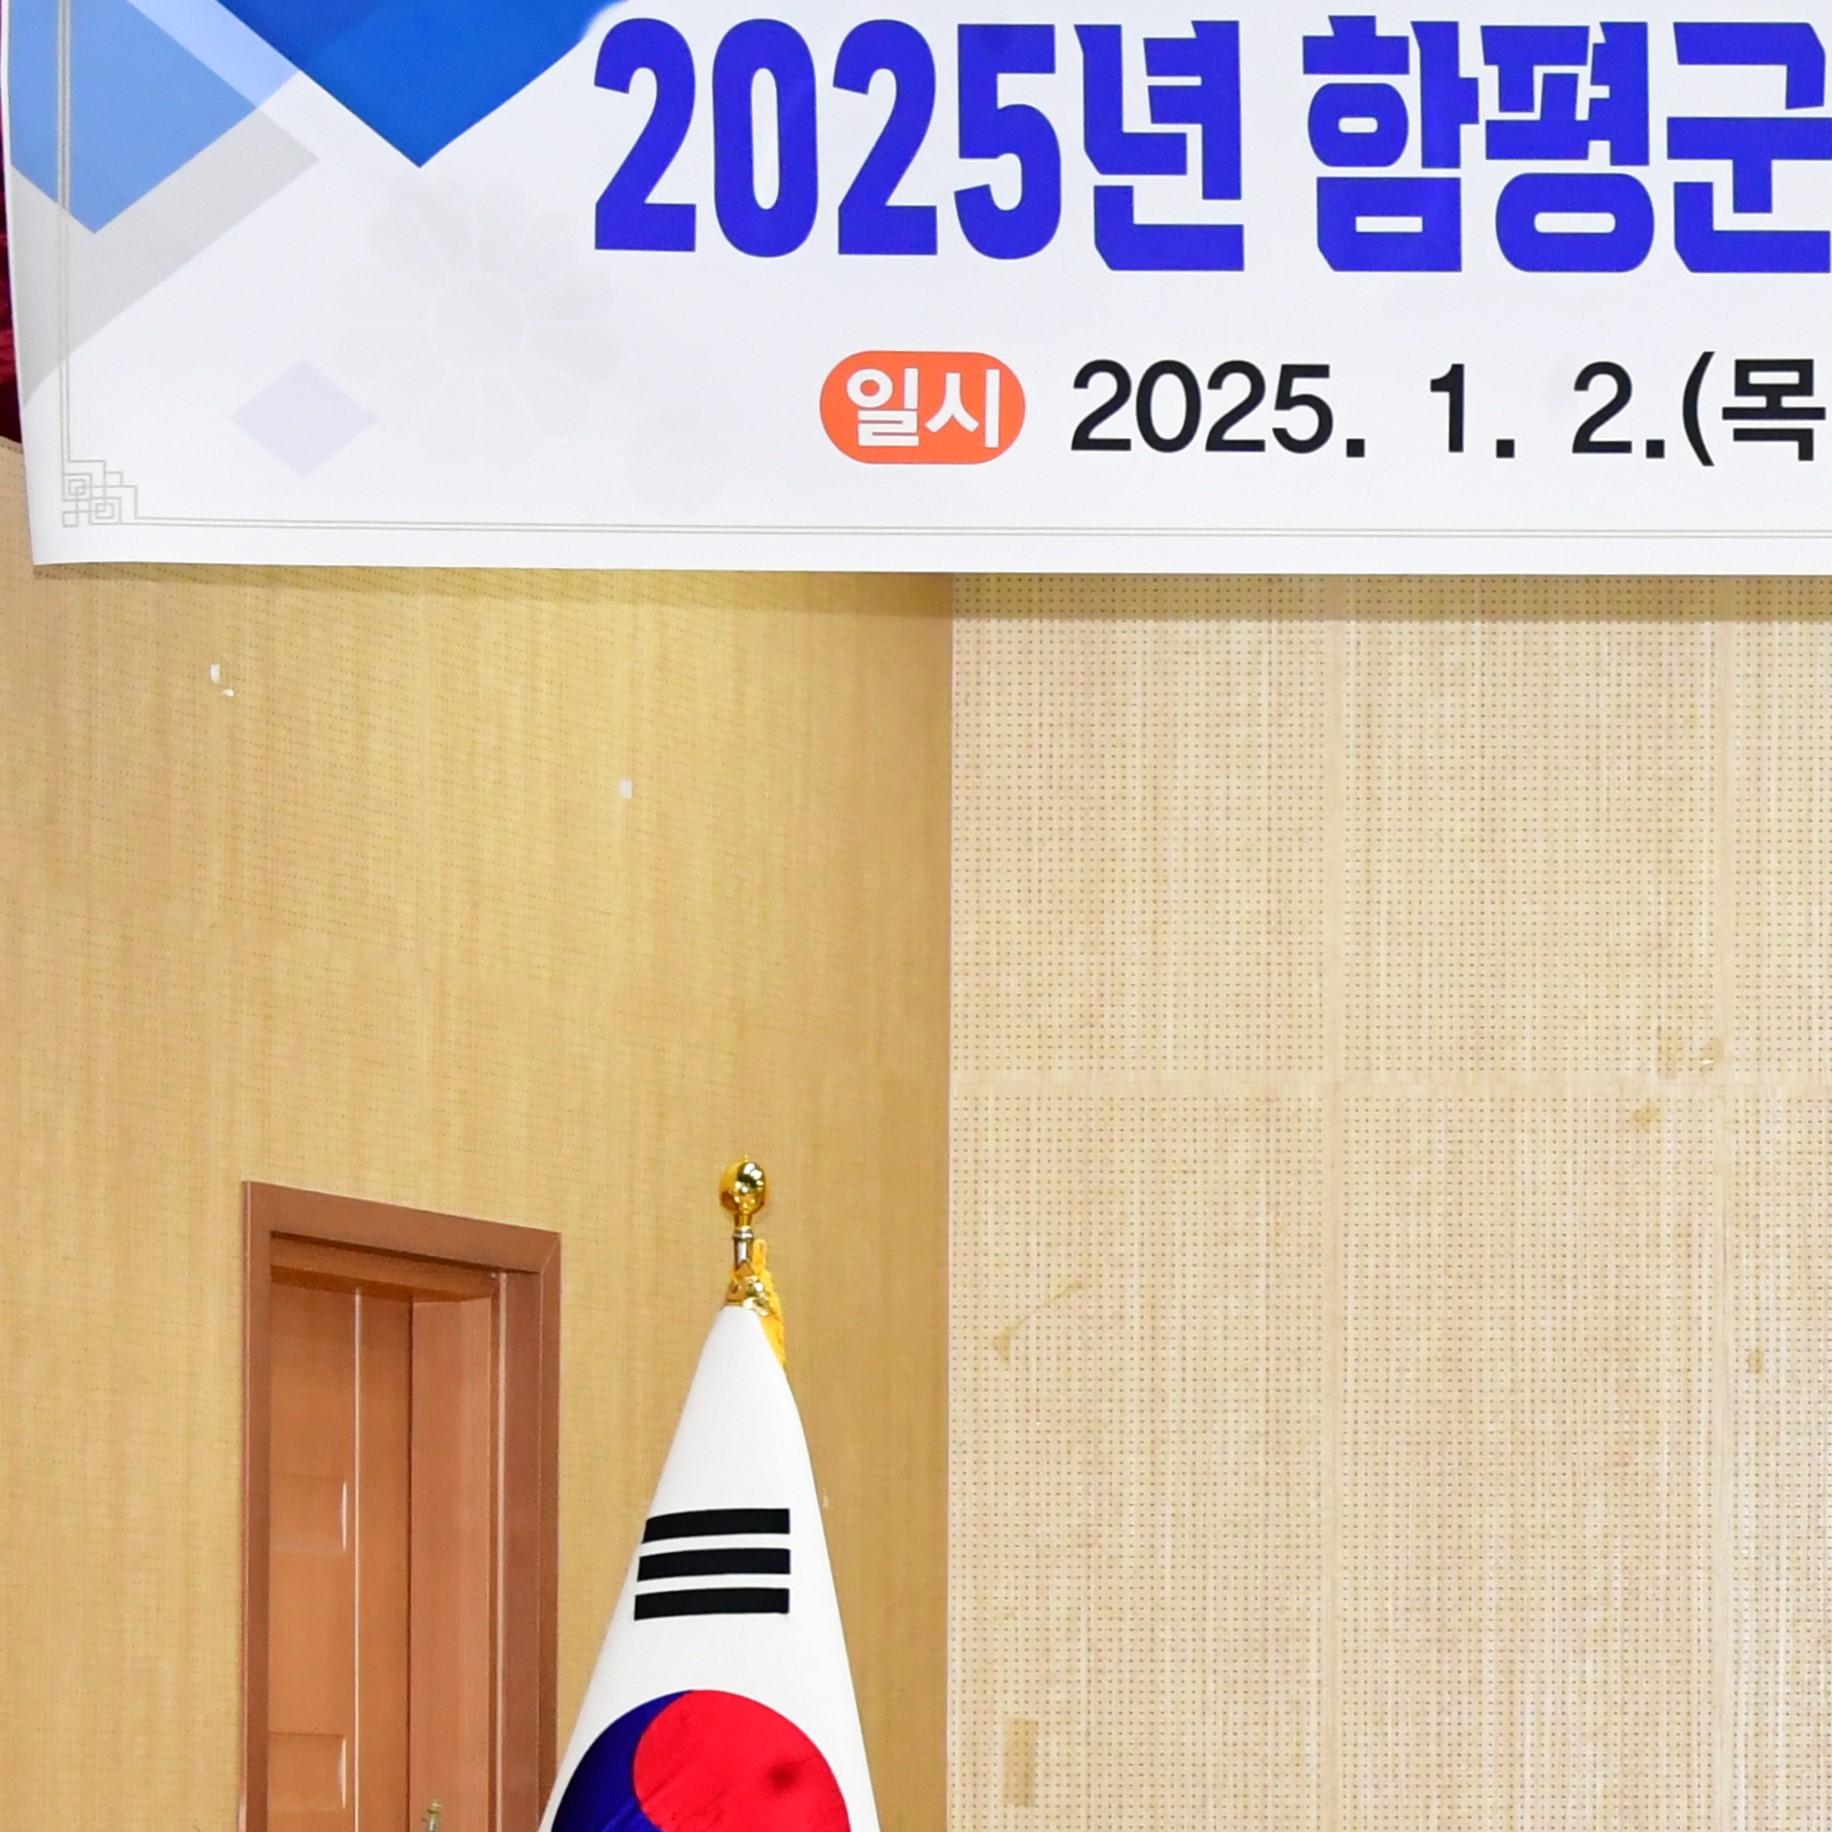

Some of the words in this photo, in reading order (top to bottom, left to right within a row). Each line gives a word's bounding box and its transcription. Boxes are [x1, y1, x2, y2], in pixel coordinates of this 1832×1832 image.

[595, 18, 1245, 272] 2025년
[844, 367, 1004, 451] 일시
[1071, 359, 1366, 459] 2025.
[1430, 363, 1516, 459] 1.
